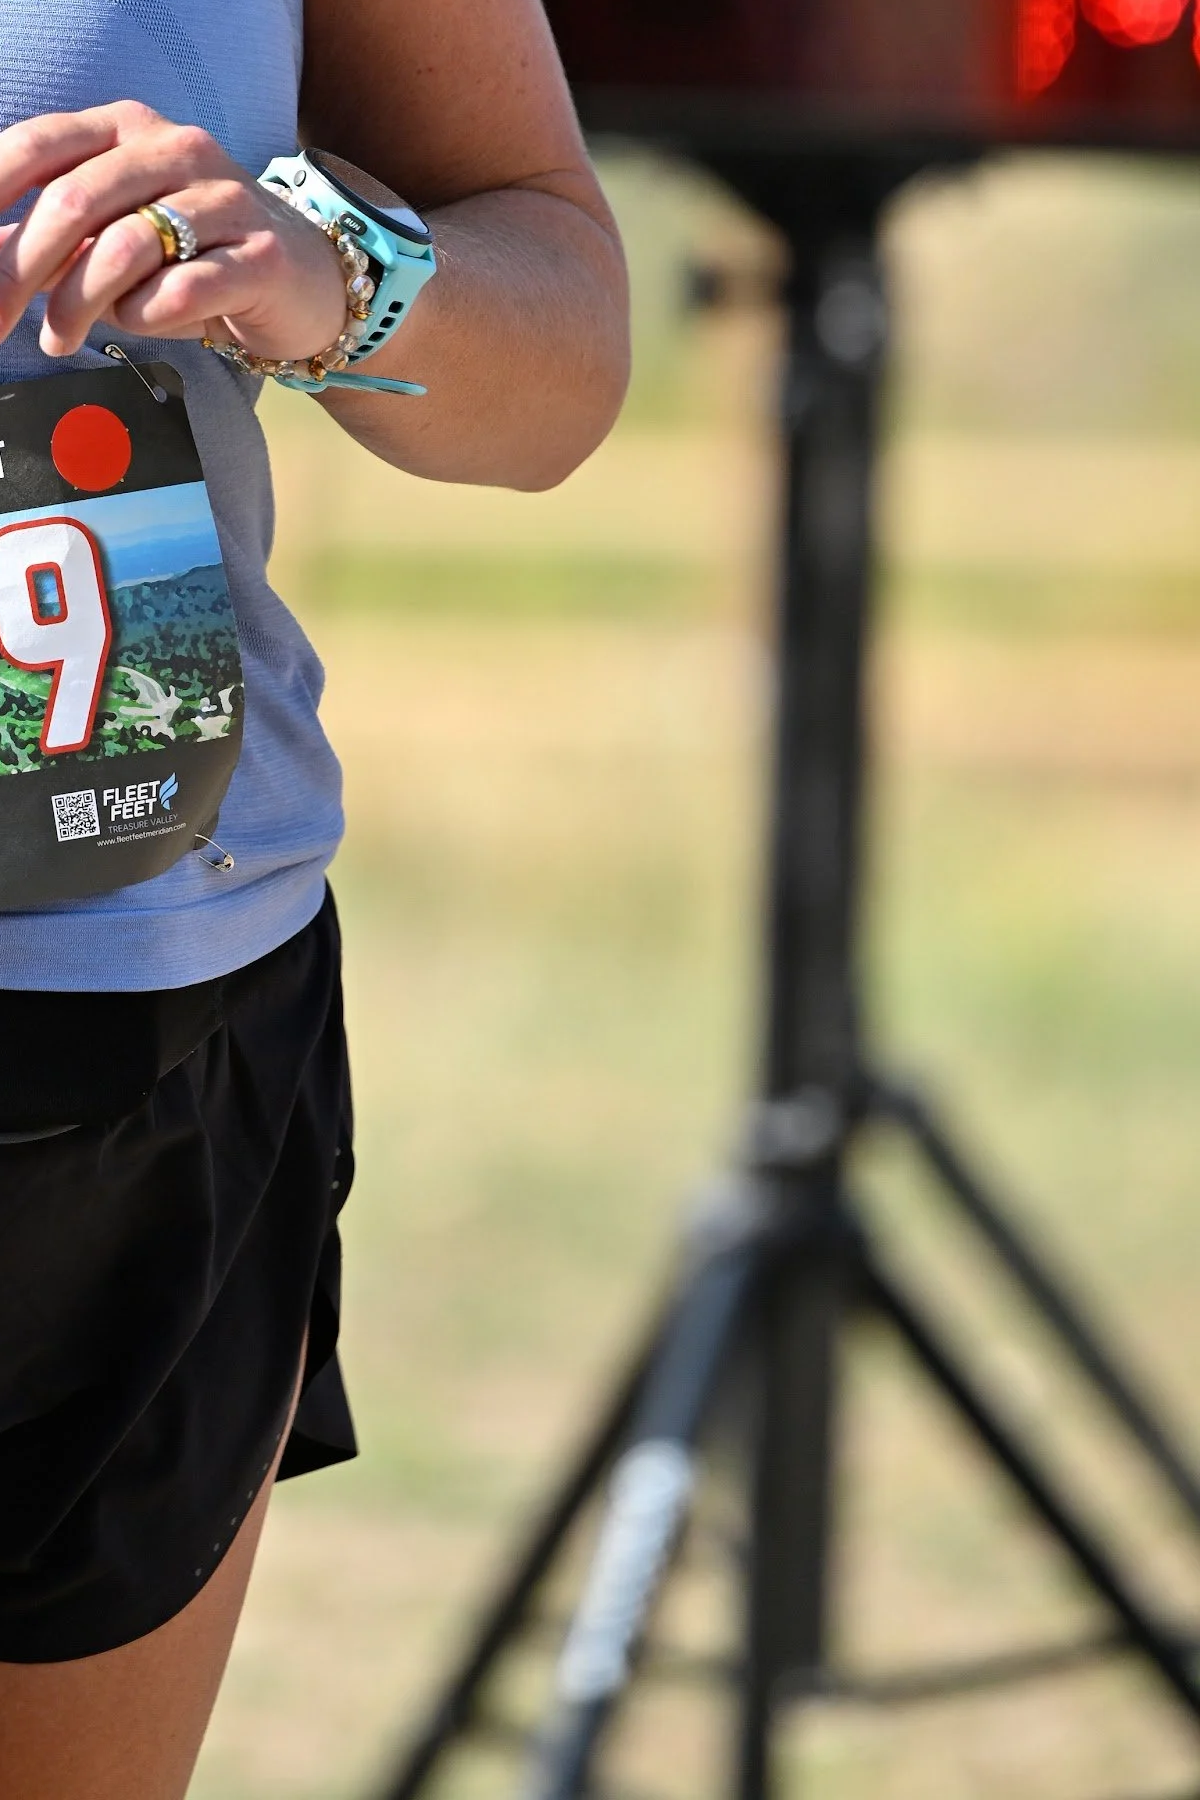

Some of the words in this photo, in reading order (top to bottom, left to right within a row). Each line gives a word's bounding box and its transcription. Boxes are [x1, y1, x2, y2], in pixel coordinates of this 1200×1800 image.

[344, 217, 361, 231] RUN
[103, 780, 161, 807] FLEET
[110, 797, 158, 822] FEET
[96, 822, 187, 847] www.fleetfeetmeridian.com
[108, 819, 149, 834] TREASURE
[150, 813, 179, 826] VALLEY
